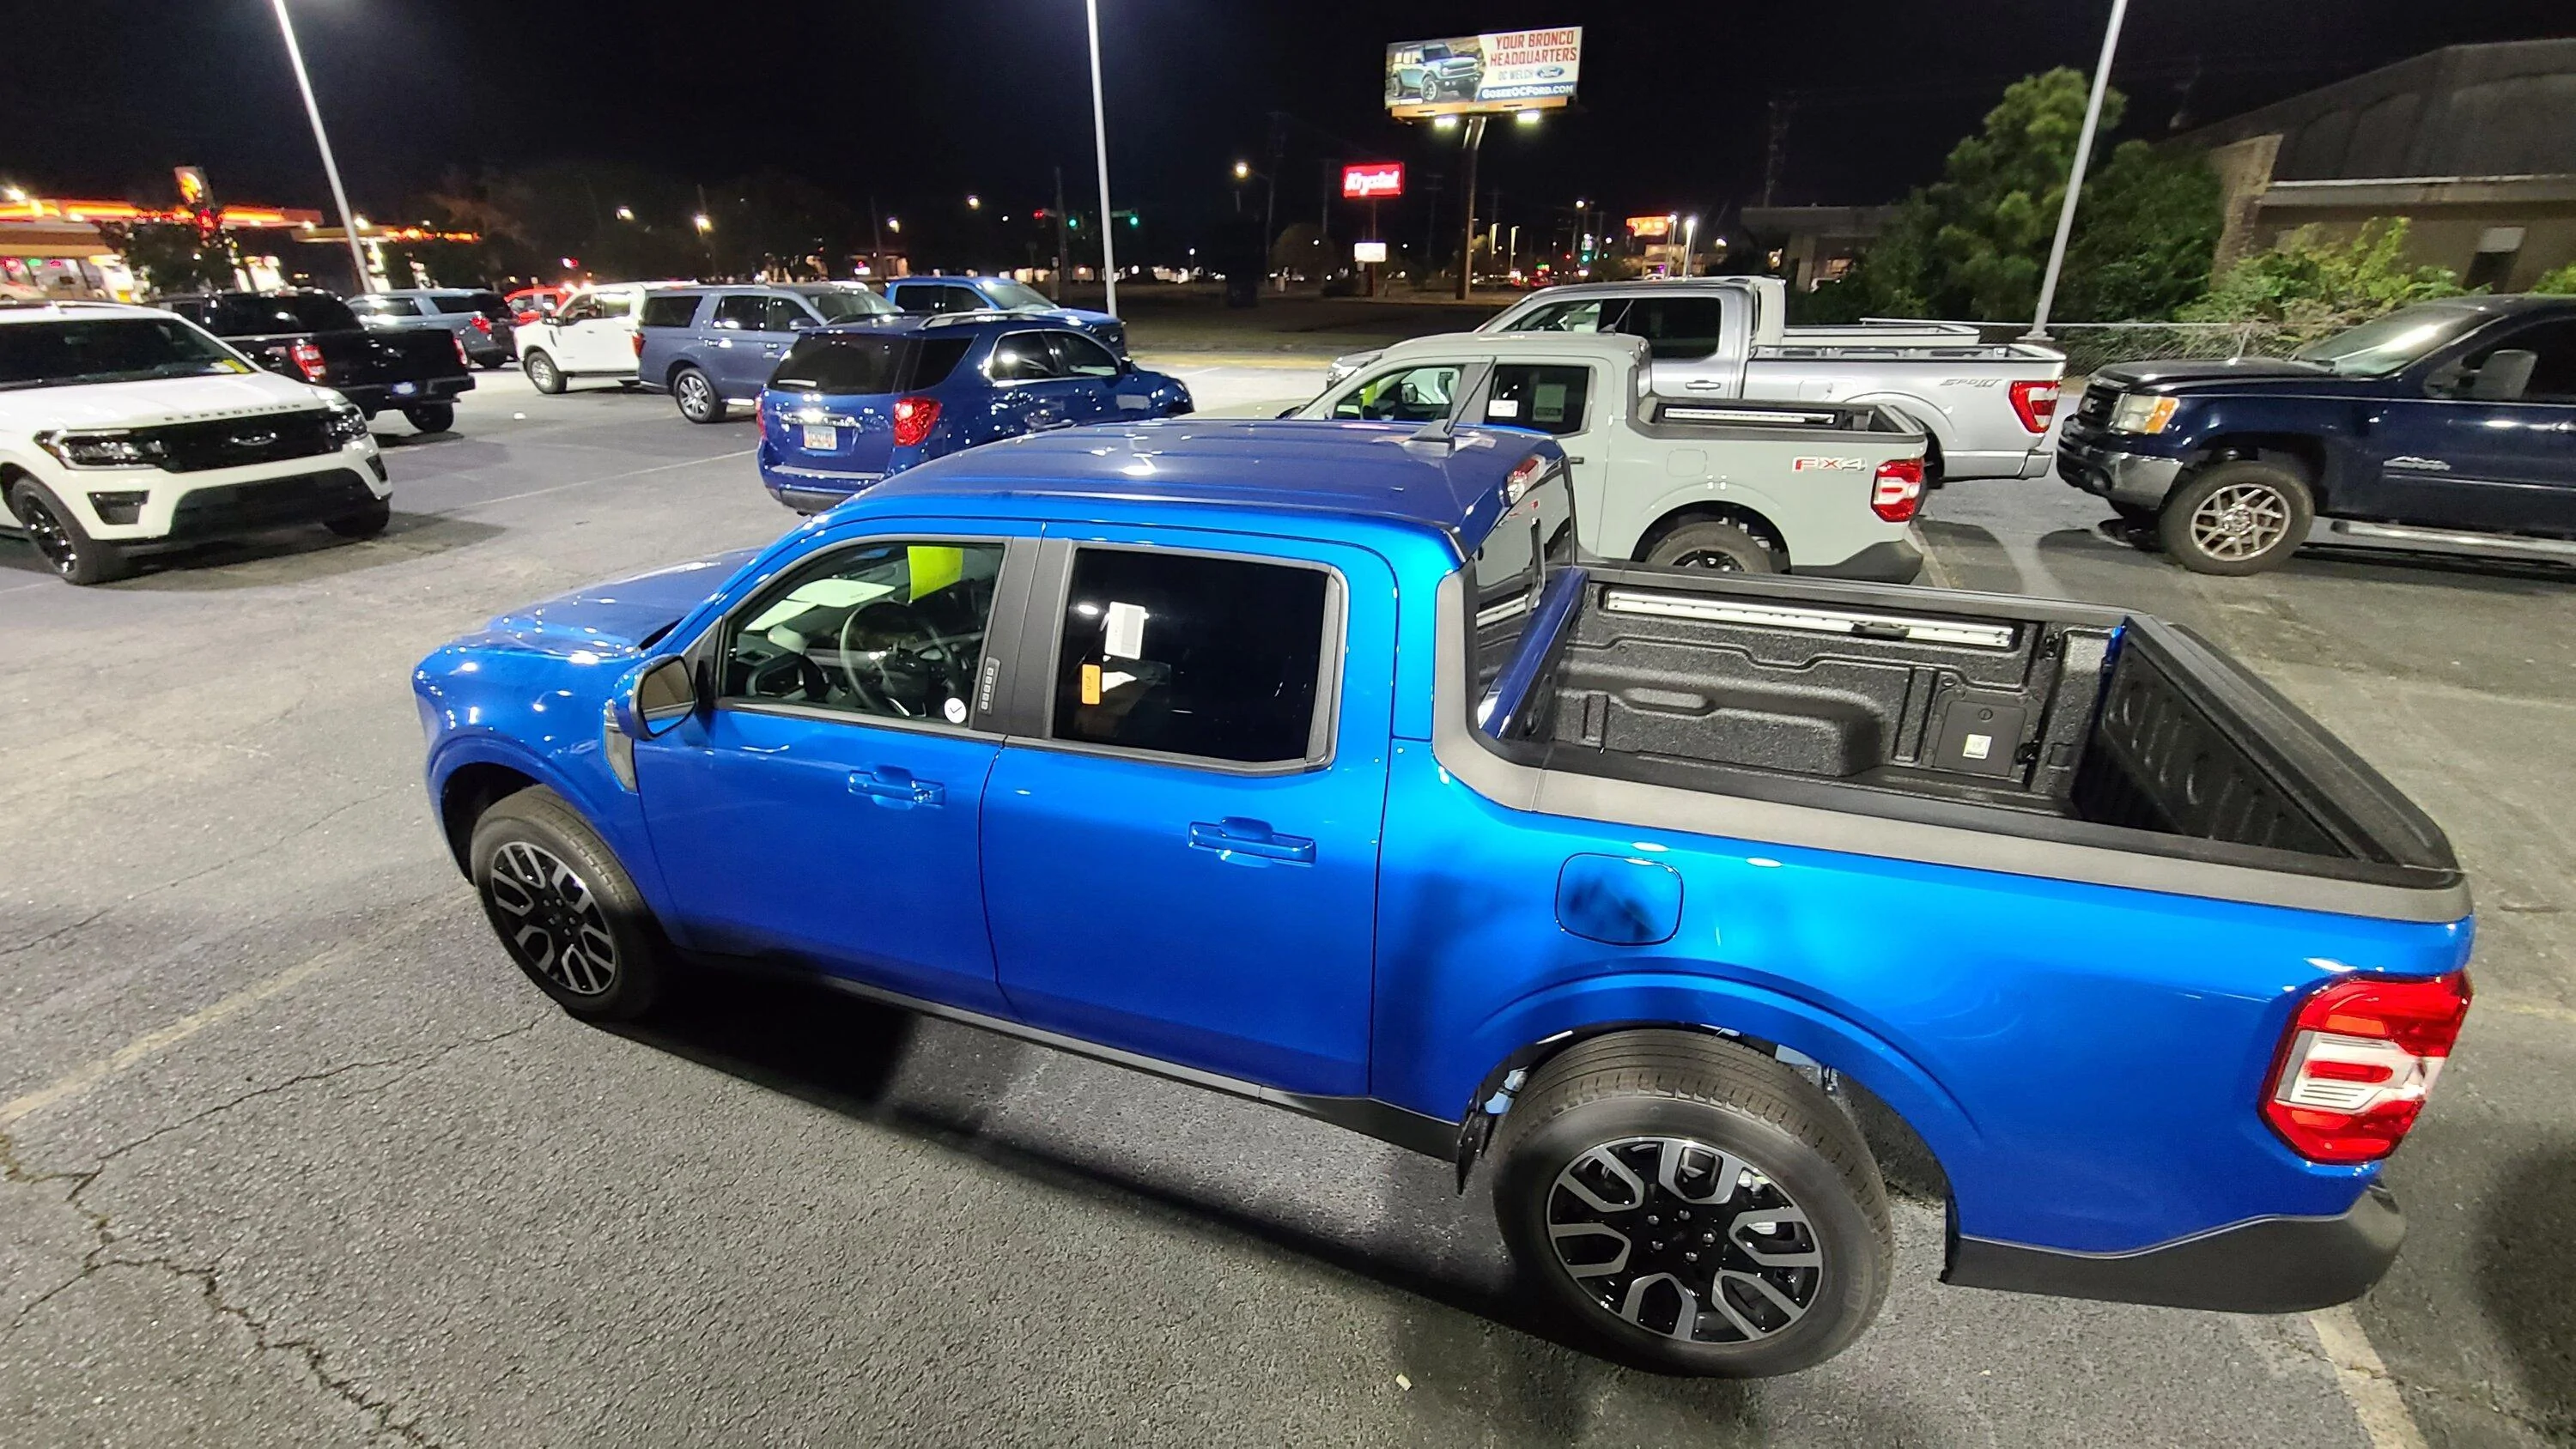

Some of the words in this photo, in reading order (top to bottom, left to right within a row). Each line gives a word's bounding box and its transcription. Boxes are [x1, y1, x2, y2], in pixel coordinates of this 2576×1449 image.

[1496, 34, 1525, 50] YOUR
[1528, 30, 1575, 47] BRONCO
[1490, 47, 1577, 66] HEADQUARTERS
[1344, 170, 1400, 196] Krystal
[1792, 456, 1867, 473] FX4
